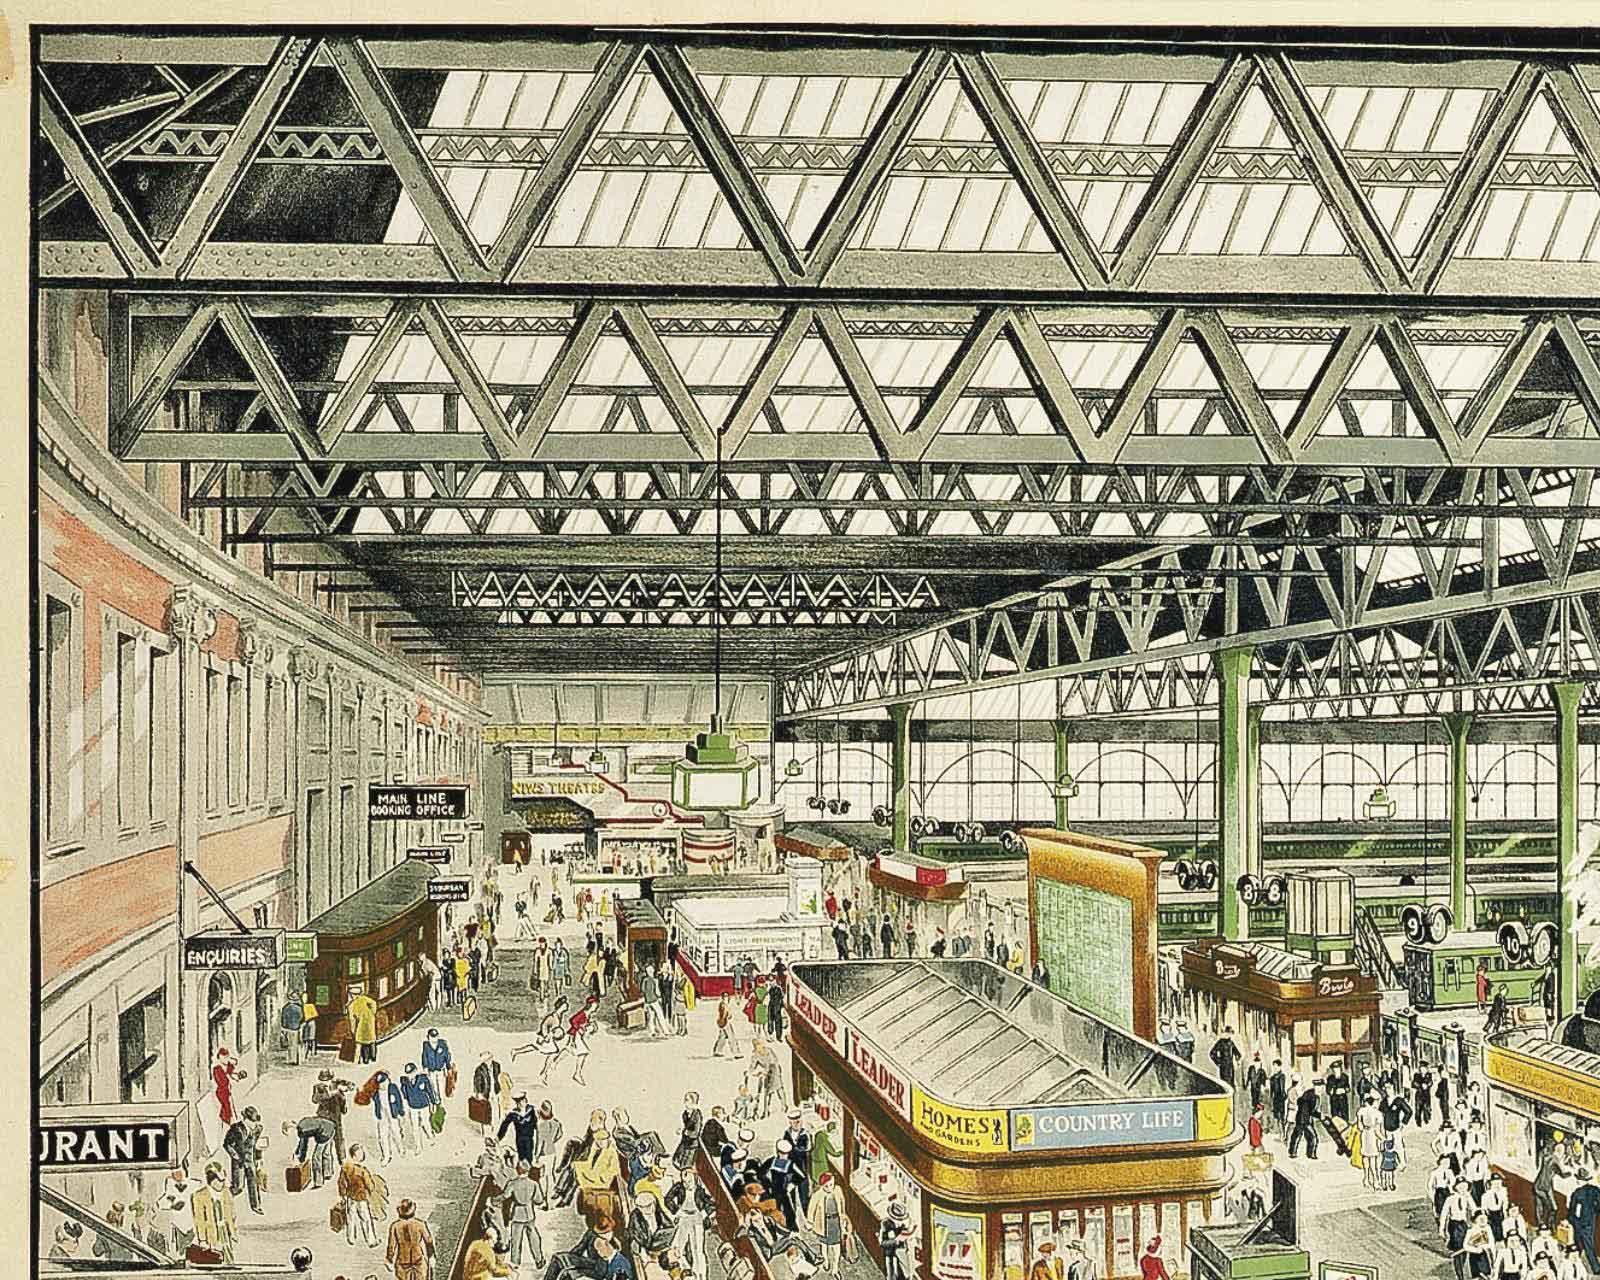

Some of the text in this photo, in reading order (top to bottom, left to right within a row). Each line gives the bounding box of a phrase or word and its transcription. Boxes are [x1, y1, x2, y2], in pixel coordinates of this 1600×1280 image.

[378, 792, 446, 805] MAIN LINE
[370, 804, 455, 816] BOOKING OFFICE
[1408, 917, 1418, 936] 9
[1506, 936, 1519, 950] 10
[187, 946, 266, 968] ENQUIRIES
[794, 988, 838, 1044] LEADER
[852, 1039, 905, 1111] LEADER
[921, 1101, 989, 1134] HOMES
[1038, 1109, 1184, 1133] COUNTRY LIFE
[934, 1129, 981, 1147] GARDENS
